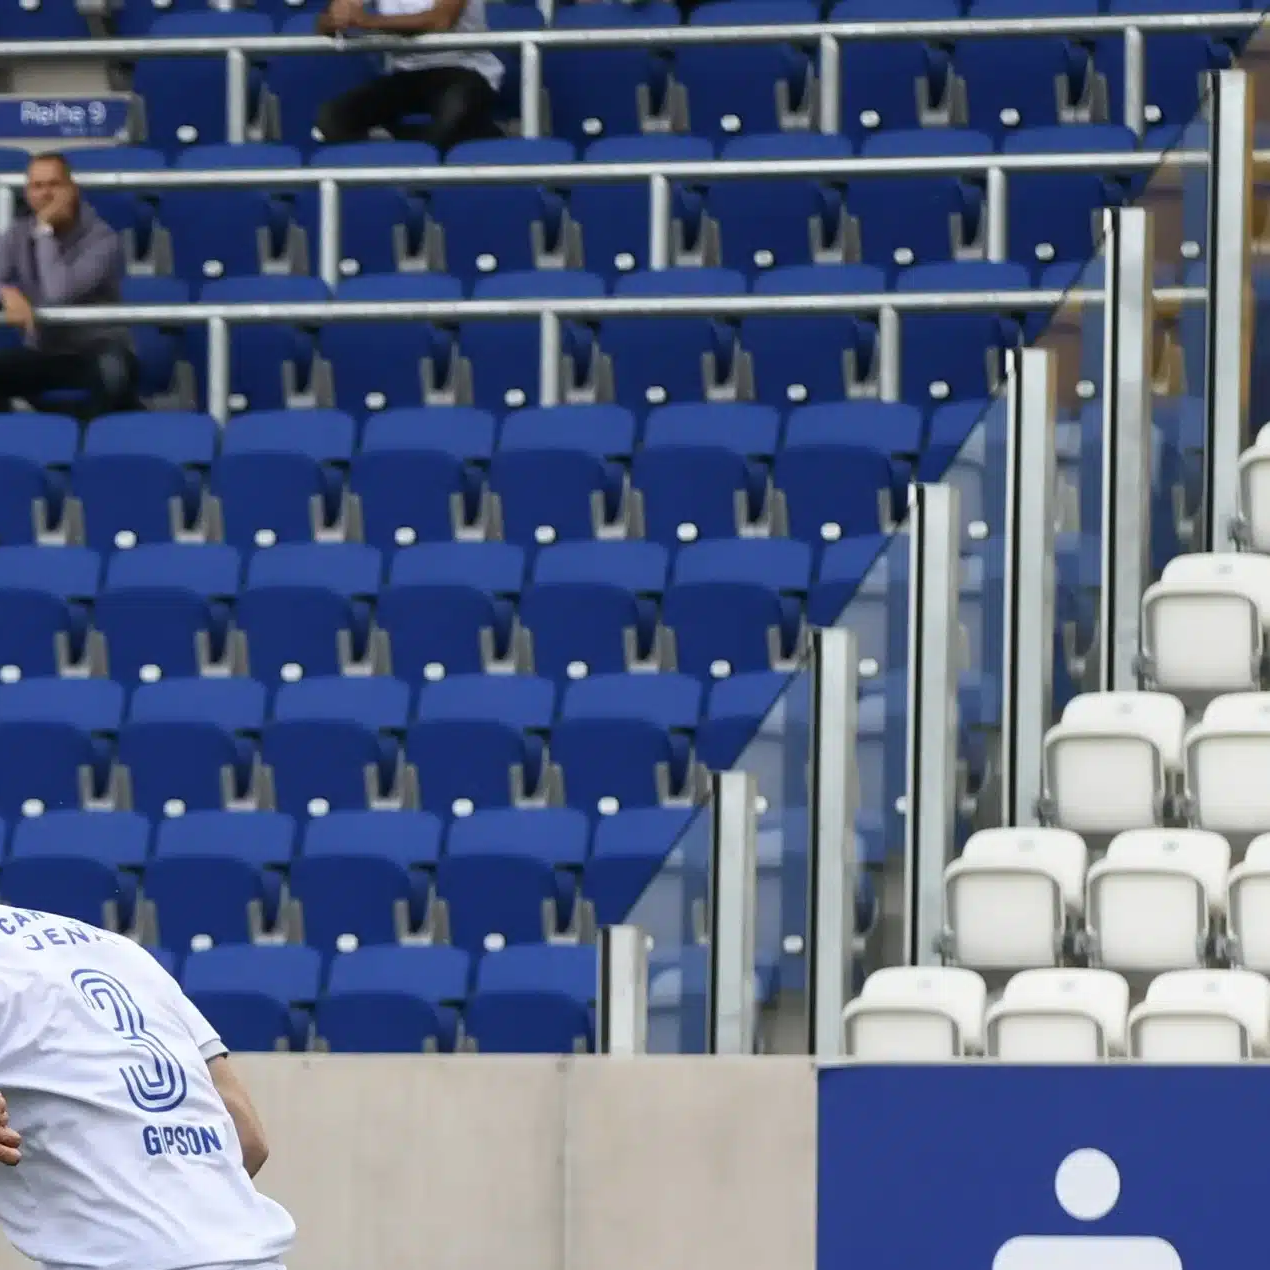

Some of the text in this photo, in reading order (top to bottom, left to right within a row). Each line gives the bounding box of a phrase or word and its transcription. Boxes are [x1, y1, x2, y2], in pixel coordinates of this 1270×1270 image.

[21, 101, 107, 125] Reihe 9
[70, 968, 187, 1112] 3
